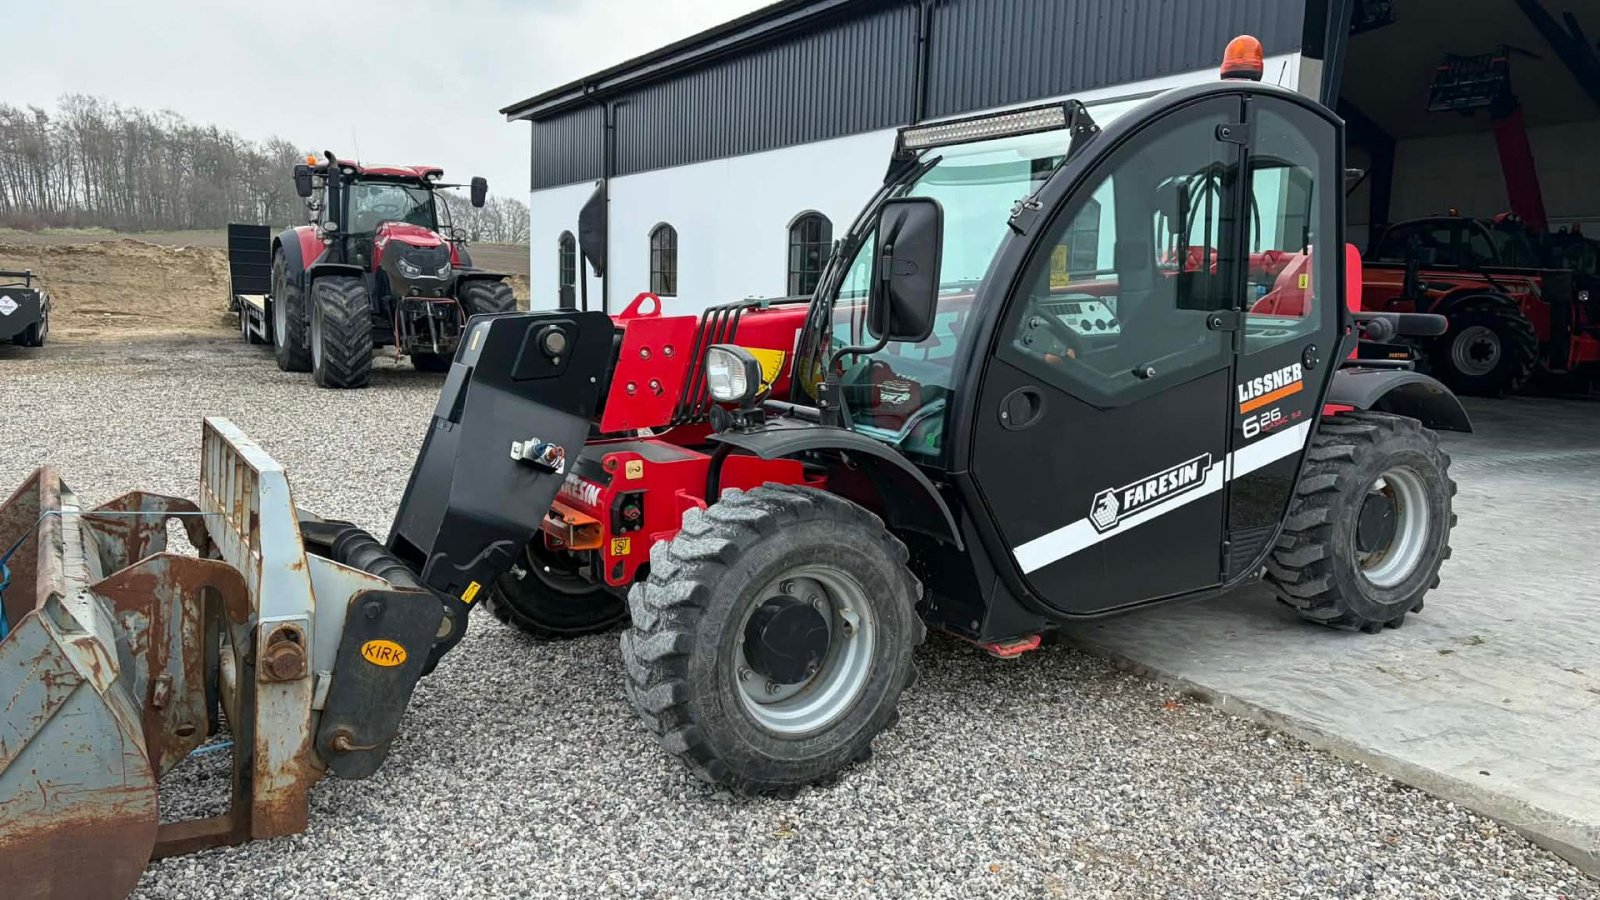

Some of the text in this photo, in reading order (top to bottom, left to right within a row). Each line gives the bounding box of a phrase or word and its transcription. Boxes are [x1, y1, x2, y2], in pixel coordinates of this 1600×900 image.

[1238, 362, 1302, 403] LISSNER
[561, 477, 602, 507] RESIN
[1124, 461, 1199, 510] FARESIN
[364, 643, 404, 663] KIRK
